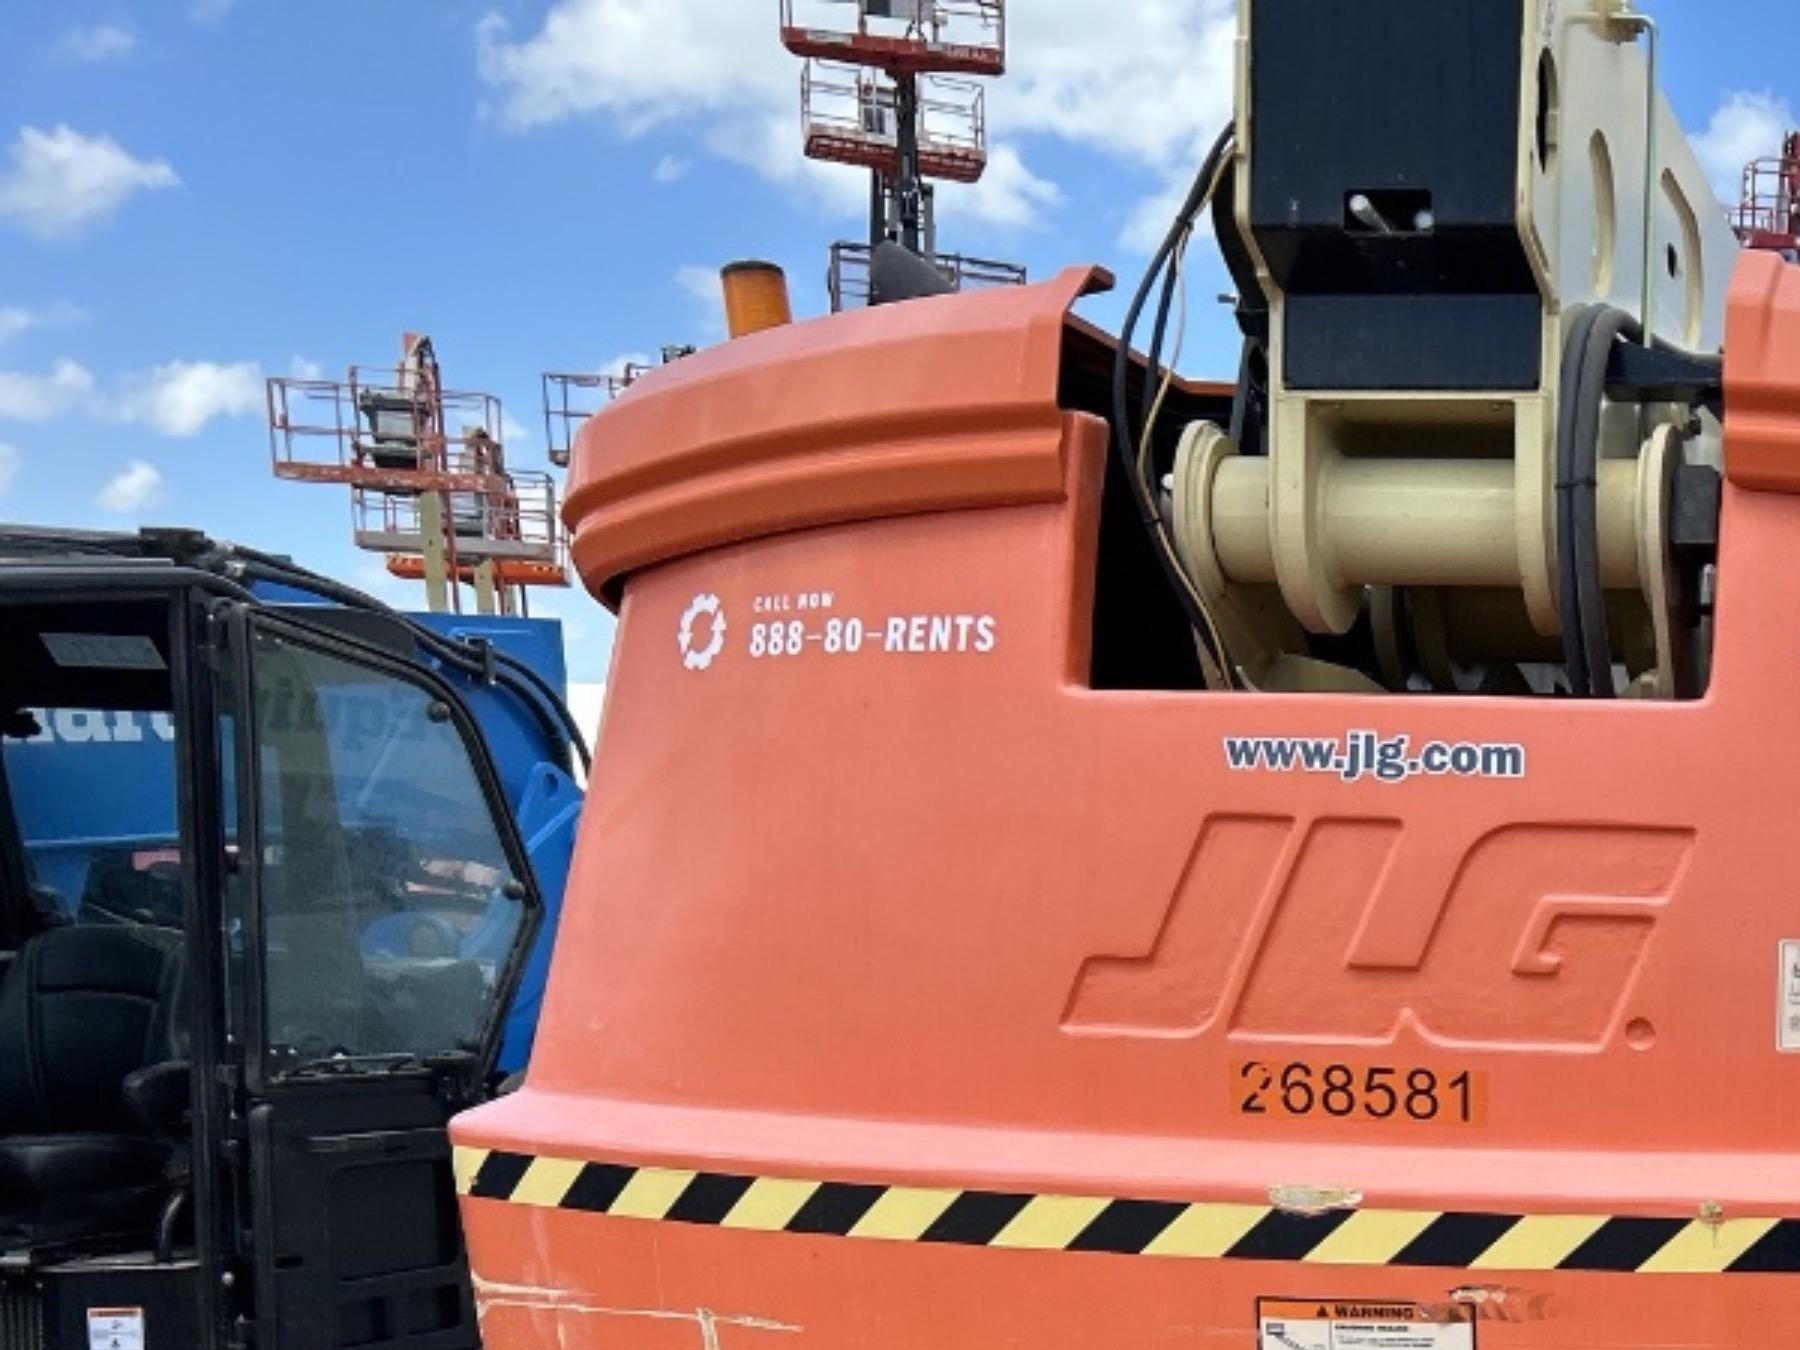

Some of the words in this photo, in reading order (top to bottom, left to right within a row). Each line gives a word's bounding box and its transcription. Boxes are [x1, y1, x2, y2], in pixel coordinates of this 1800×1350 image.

[753, 594, 790, 612] CALL
[798, 592, 835, 609] NOW
[750, 614, 996, 657] 888-80-RENTS
[1224, 729, 1525, 783] www.jlg.com
[1059, 811, 1698, 1053] JLG
[1240, 1062, 1472, 1122] 268581
[1334, 1304, 1414, 1319] WARNING
